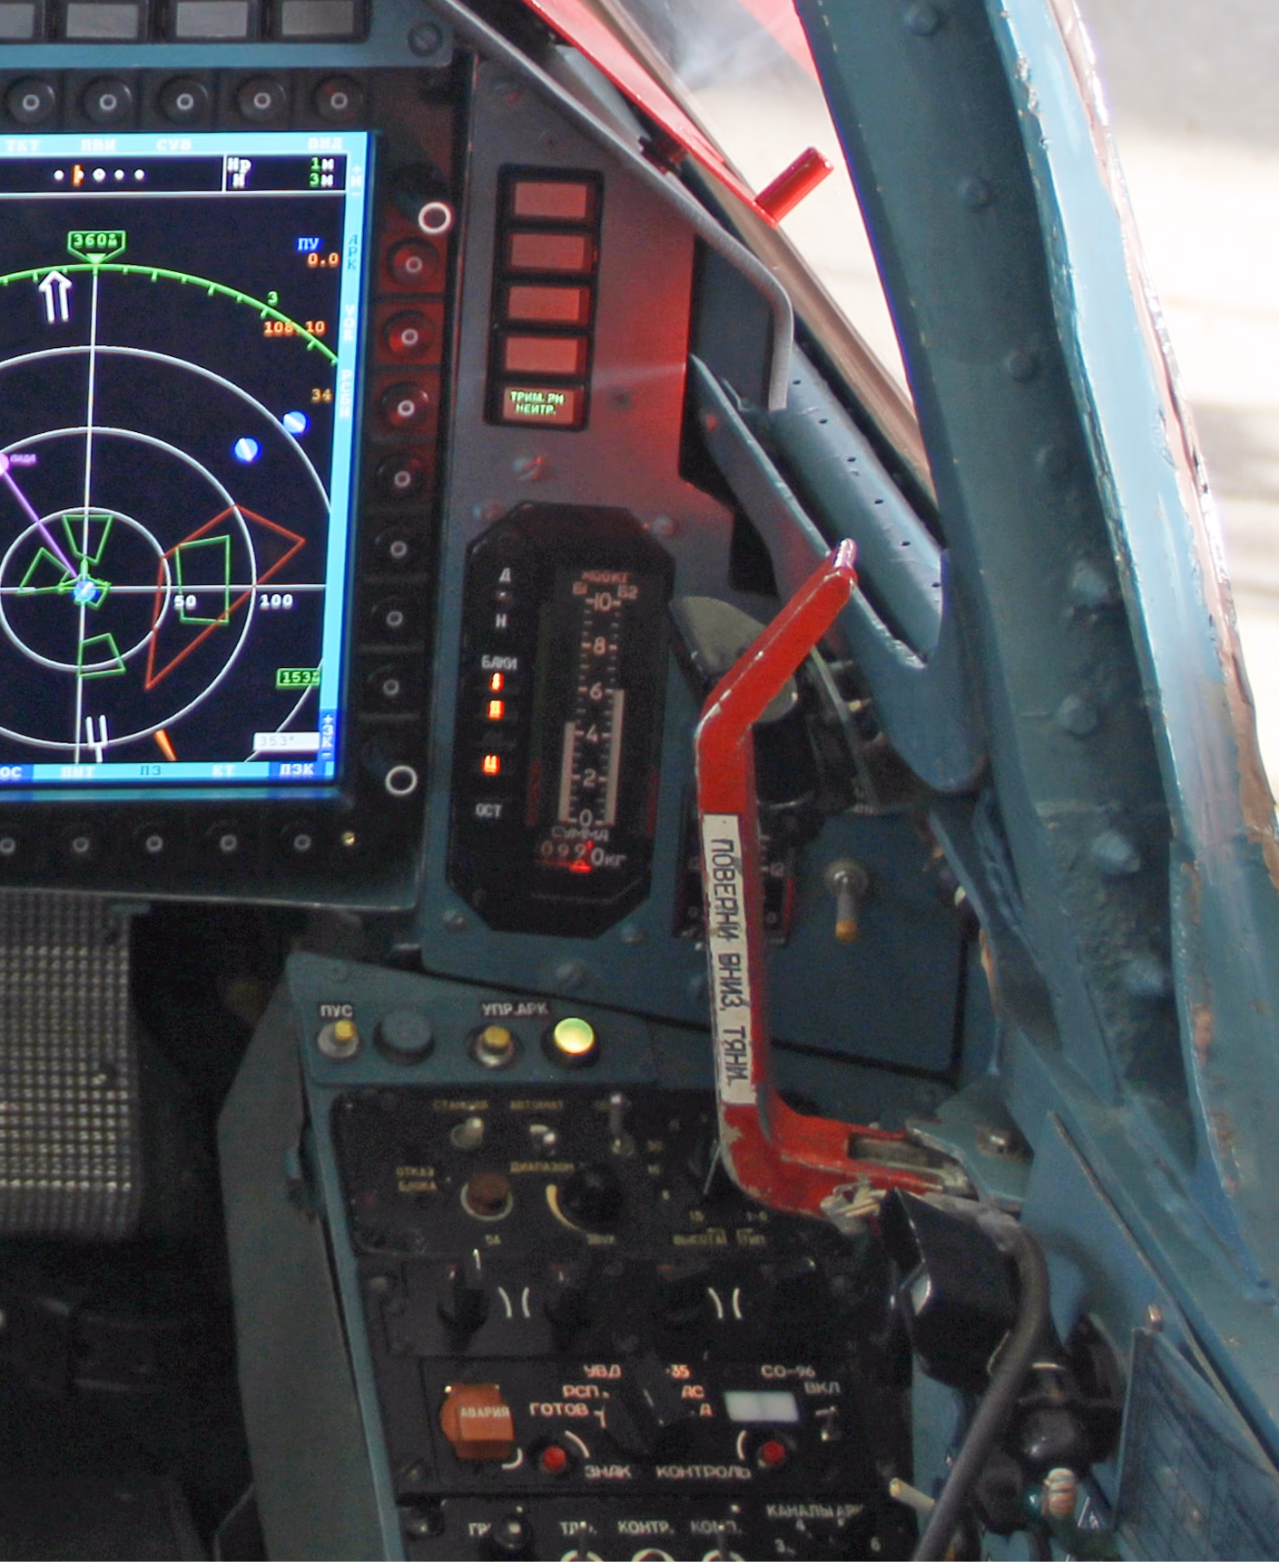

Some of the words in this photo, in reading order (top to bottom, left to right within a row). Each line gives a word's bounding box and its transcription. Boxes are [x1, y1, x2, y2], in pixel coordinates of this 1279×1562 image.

[307, 252, 340, 267] 0.0
[263, 320, 327, 337] 108.10
[510, 390, 545, 404] ТРИМ.
[499, 567, 512, 584] Д
[173, 594, 197, 608] 50
[259, 593, 293, 608] 100
[593, 593, 612, 612] 10
[496, 614, 508, 628] Н
[481, 655, 518, 672] БАКИ
[475, 802, 502, 818] ОСТ
[710, 838, 739, 942] ПОВЕРНИ
[320, 1003, 353, 1018] ПУС
[583, 1364, 621, 1379] УВД
[760, 1364, 816, 1378] СО-96
[562, 1385, 600, 1398] РСП
[804, 1381, 841, 1395] ВКЛ
[460, 1406, 511, 1418] АВАРИЯ
[530, 1403, 590, 1417] ГОТОВ
[584, 1465, 632, 1479] ЗНАК
[656, 1464, 752, 1479] КОНТРОЛЬ
[766, 1504, 833, 1518] КАНАЛЫ
[617, 1520, 674, 1534] КОНТР.
